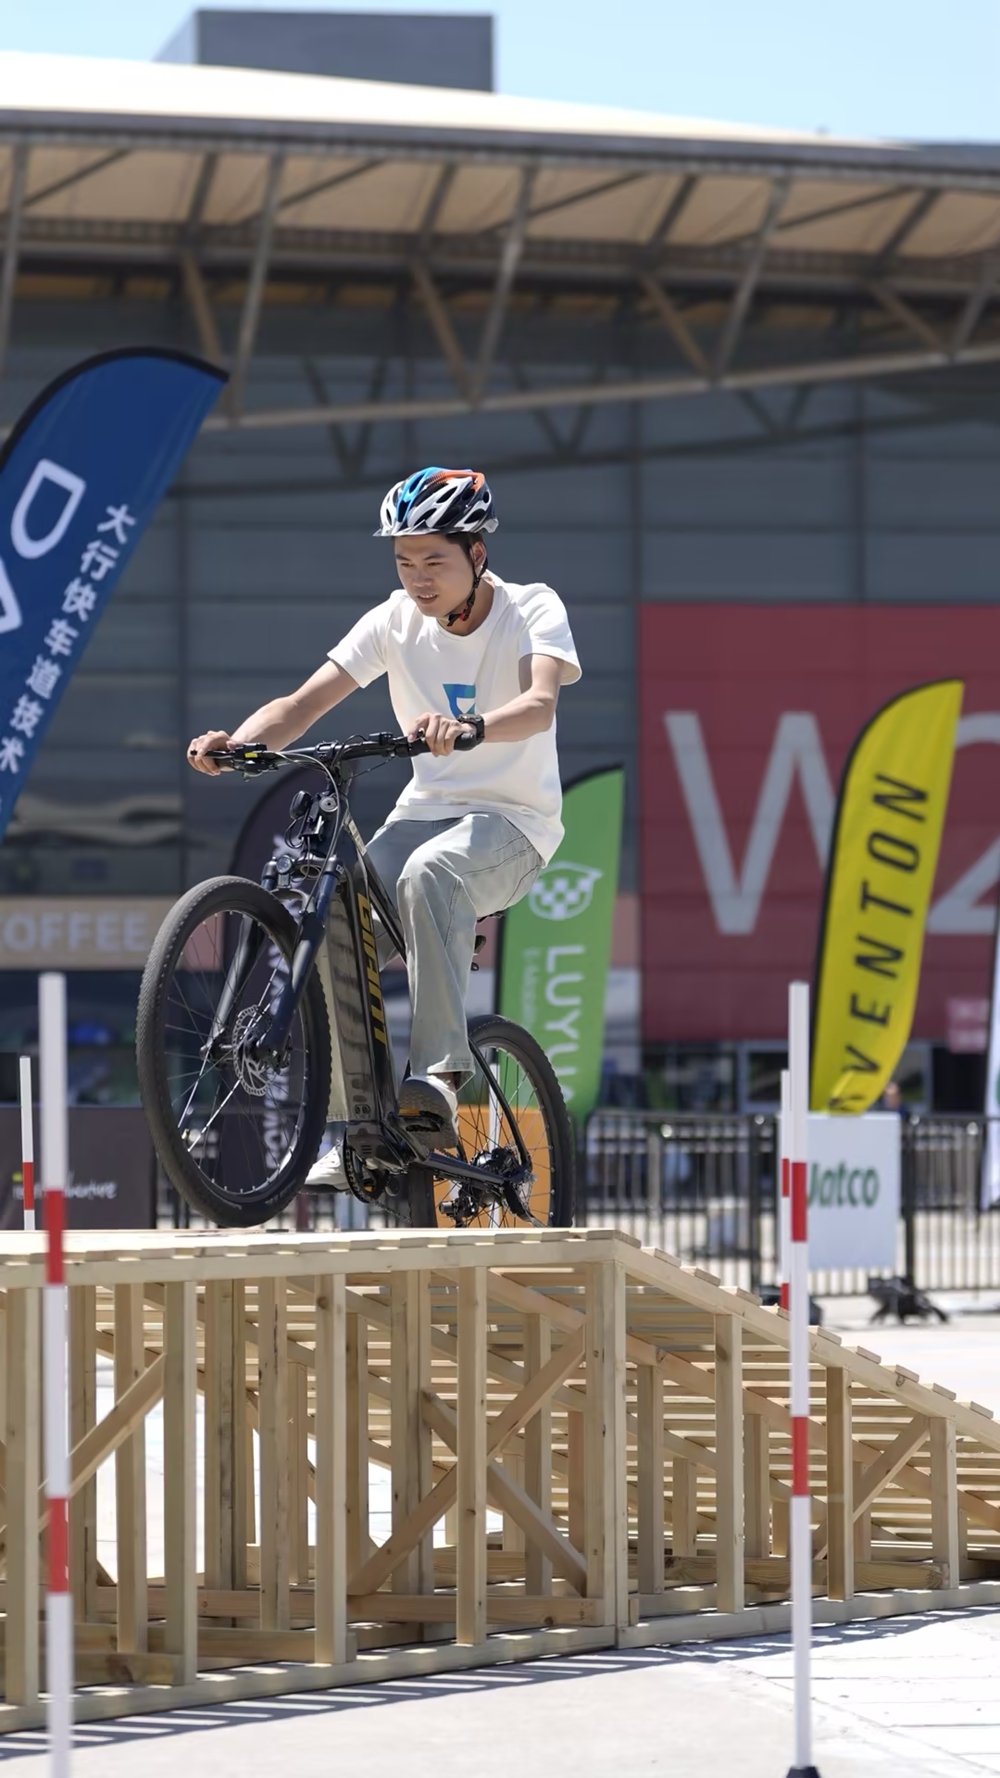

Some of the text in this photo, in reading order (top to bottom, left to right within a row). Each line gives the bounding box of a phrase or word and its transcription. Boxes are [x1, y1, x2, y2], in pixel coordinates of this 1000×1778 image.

[0, 503, 137, 775] 大行快车道技术
[0, 911, 148, 952] OFFEE
[357, 892, 387, 1045] GIANT
